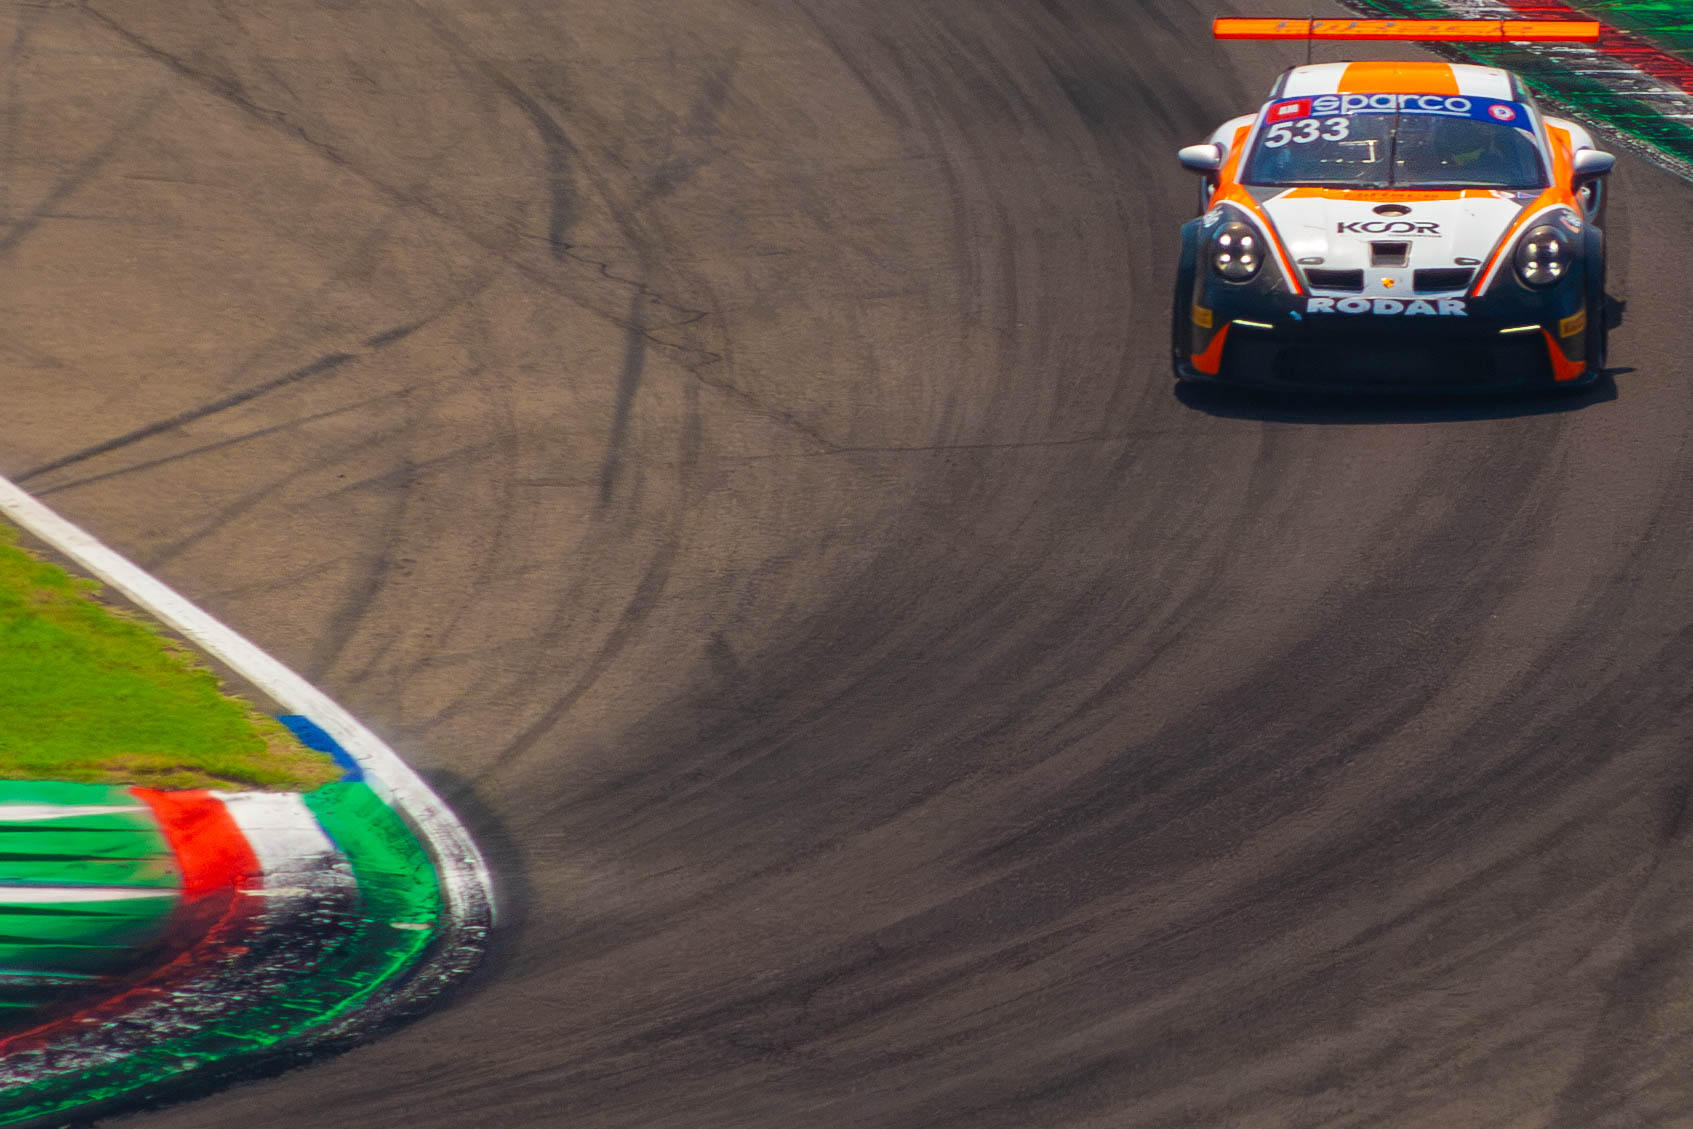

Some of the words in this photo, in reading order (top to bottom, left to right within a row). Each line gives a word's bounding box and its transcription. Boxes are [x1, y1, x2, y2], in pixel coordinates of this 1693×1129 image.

[1312, 93, 1472, 115] sparco
[1264, 117, 1350, 148] 533
[1306, 298, 1469, 316] RODAR
